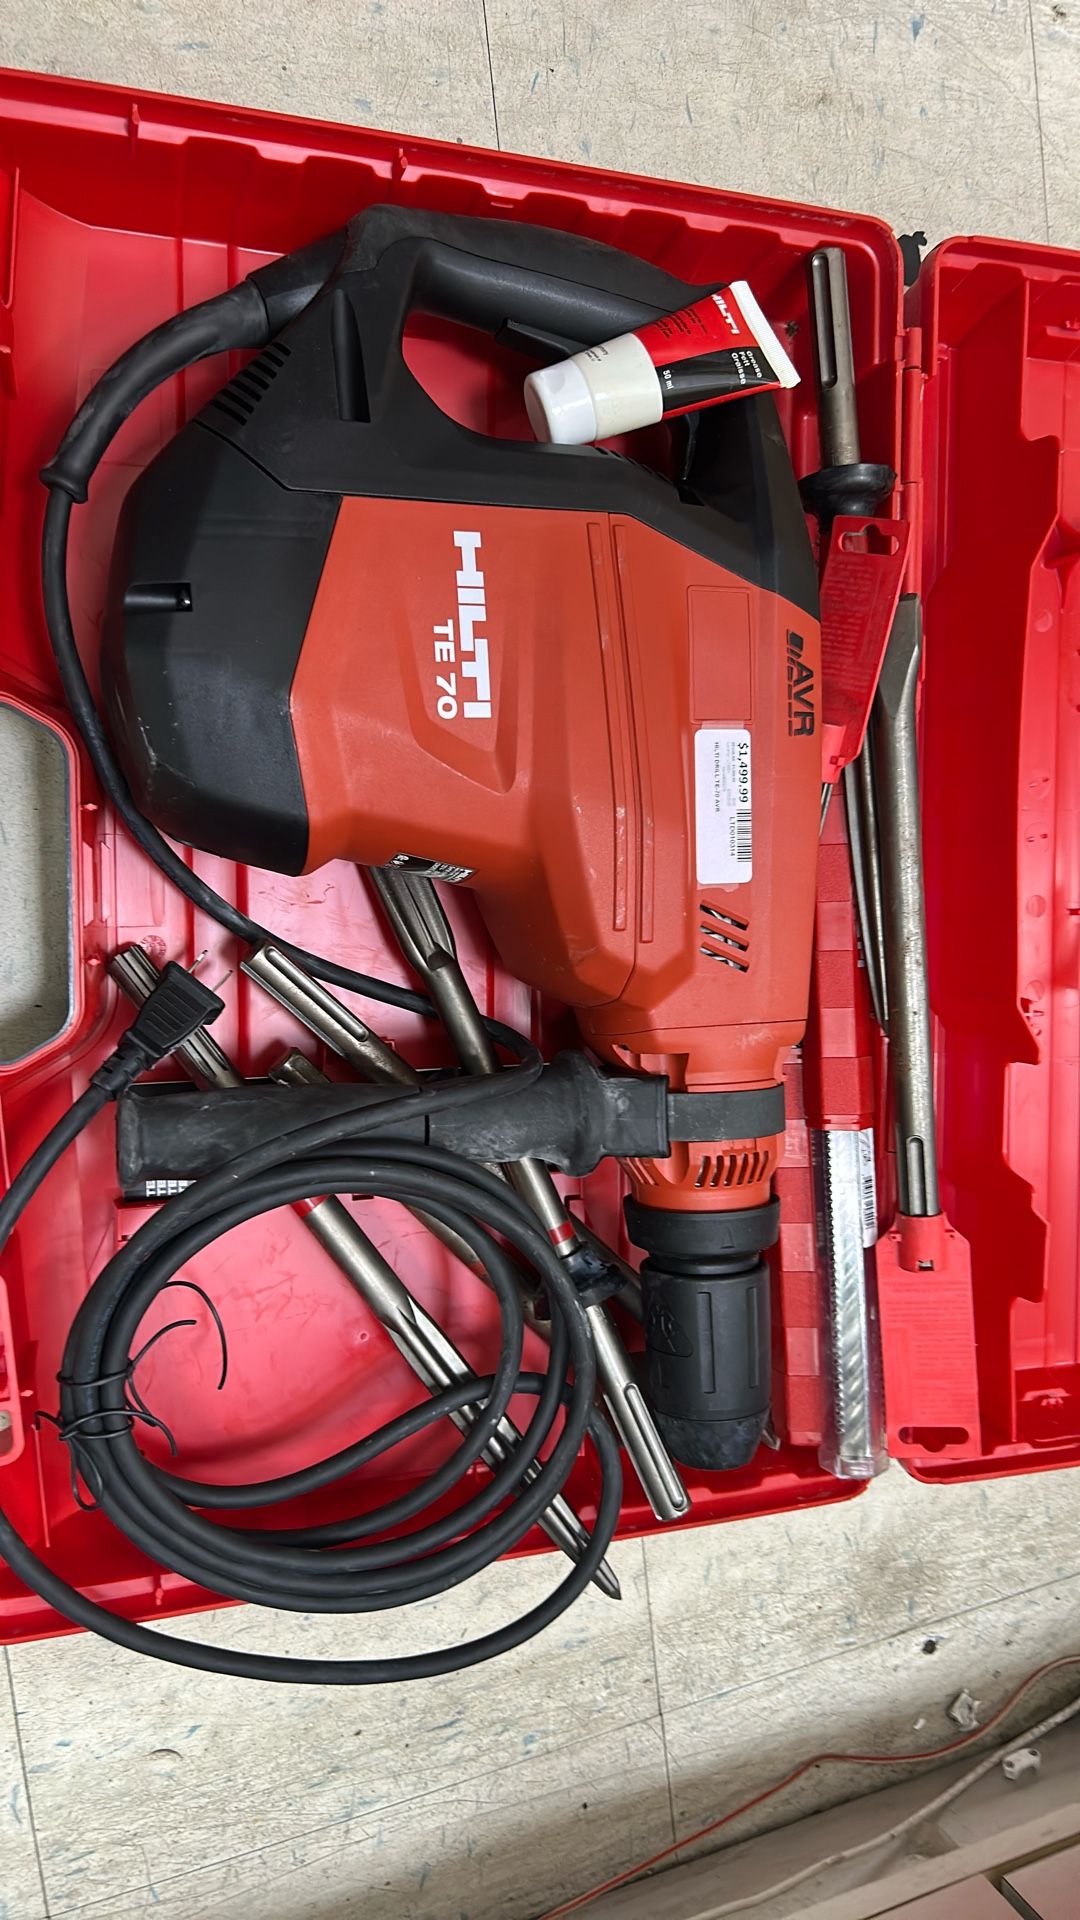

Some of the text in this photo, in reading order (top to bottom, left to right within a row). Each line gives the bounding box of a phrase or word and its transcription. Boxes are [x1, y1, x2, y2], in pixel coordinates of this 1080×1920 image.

[663, 369, 674, 390] 50 ml
[731, 352, 746, 385] Graisse
[738, 351, 750, 367] Fett
[746, 350, 763, 378] Grease
[453, 530, 492, 718] HILTI
[433, 619, 458, 720] TE 70
[793, 660, 815, 737] AVR
[737, 742, 750, 803] $1,499.99
